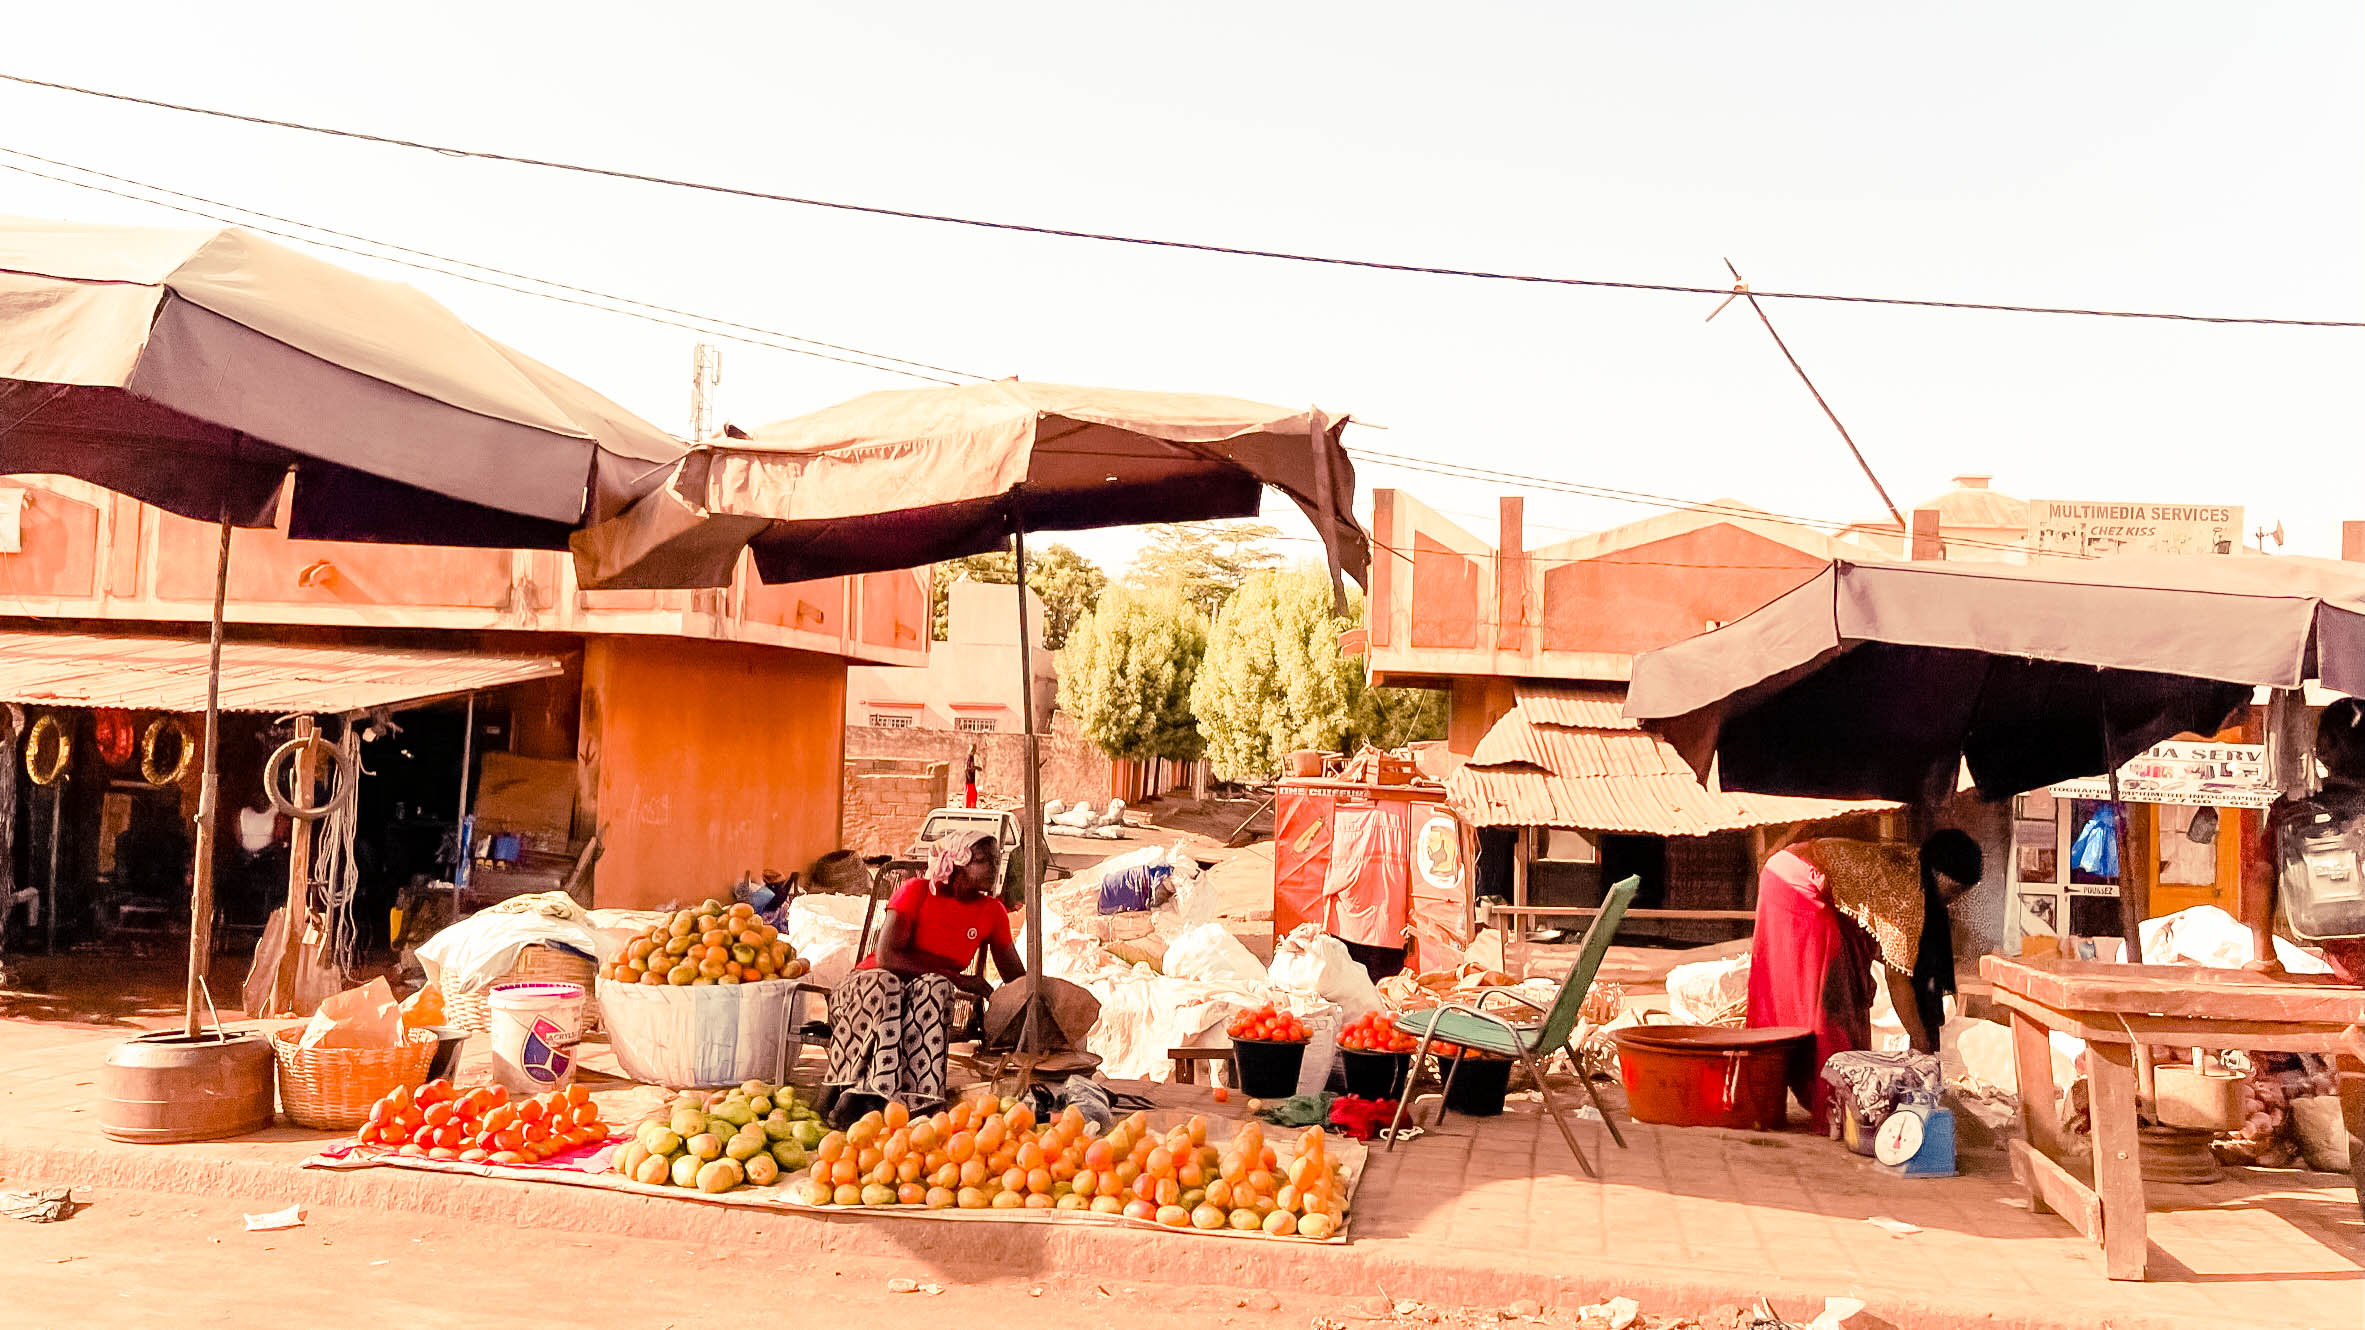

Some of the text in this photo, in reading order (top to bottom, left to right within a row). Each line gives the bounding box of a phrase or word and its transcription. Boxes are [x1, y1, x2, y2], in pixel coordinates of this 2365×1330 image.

[2049, 503, 2230, 522] MULTIMEDIA SERVICES
[2090, 525, 2156, 537] CHEZ KISS
[2083, 886, 2113, 895] POUSSEZ
